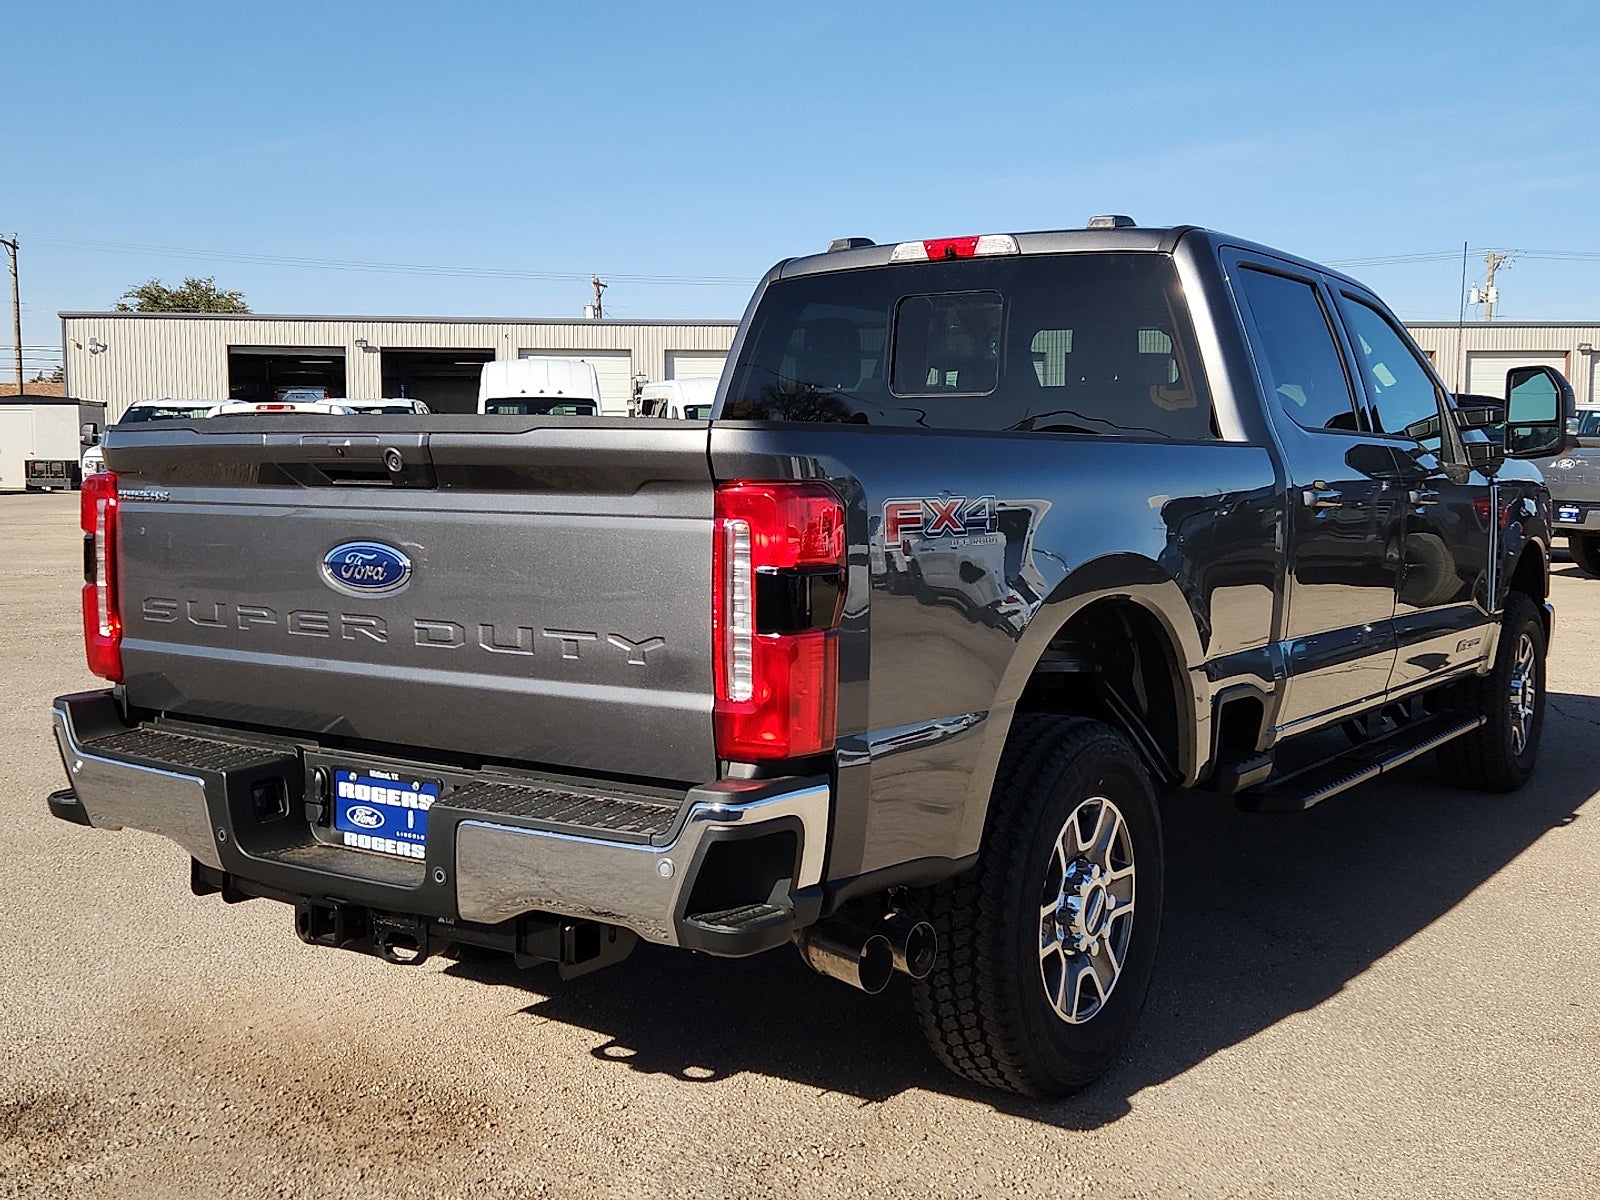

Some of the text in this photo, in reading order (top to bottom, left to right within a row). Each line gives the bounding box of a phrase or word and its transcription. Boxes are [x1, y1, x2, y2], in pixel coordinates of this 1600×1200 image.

[882, 495, 998, 551] FX4
[341, 552, 387, 581] Ford
[142, 597, 665, 667] SUPER DUTY
[338, 781, 436, 811] ROGERS
[353, 808, 378, 826] Ford
[343, 832, 425, 859] ROGERS
